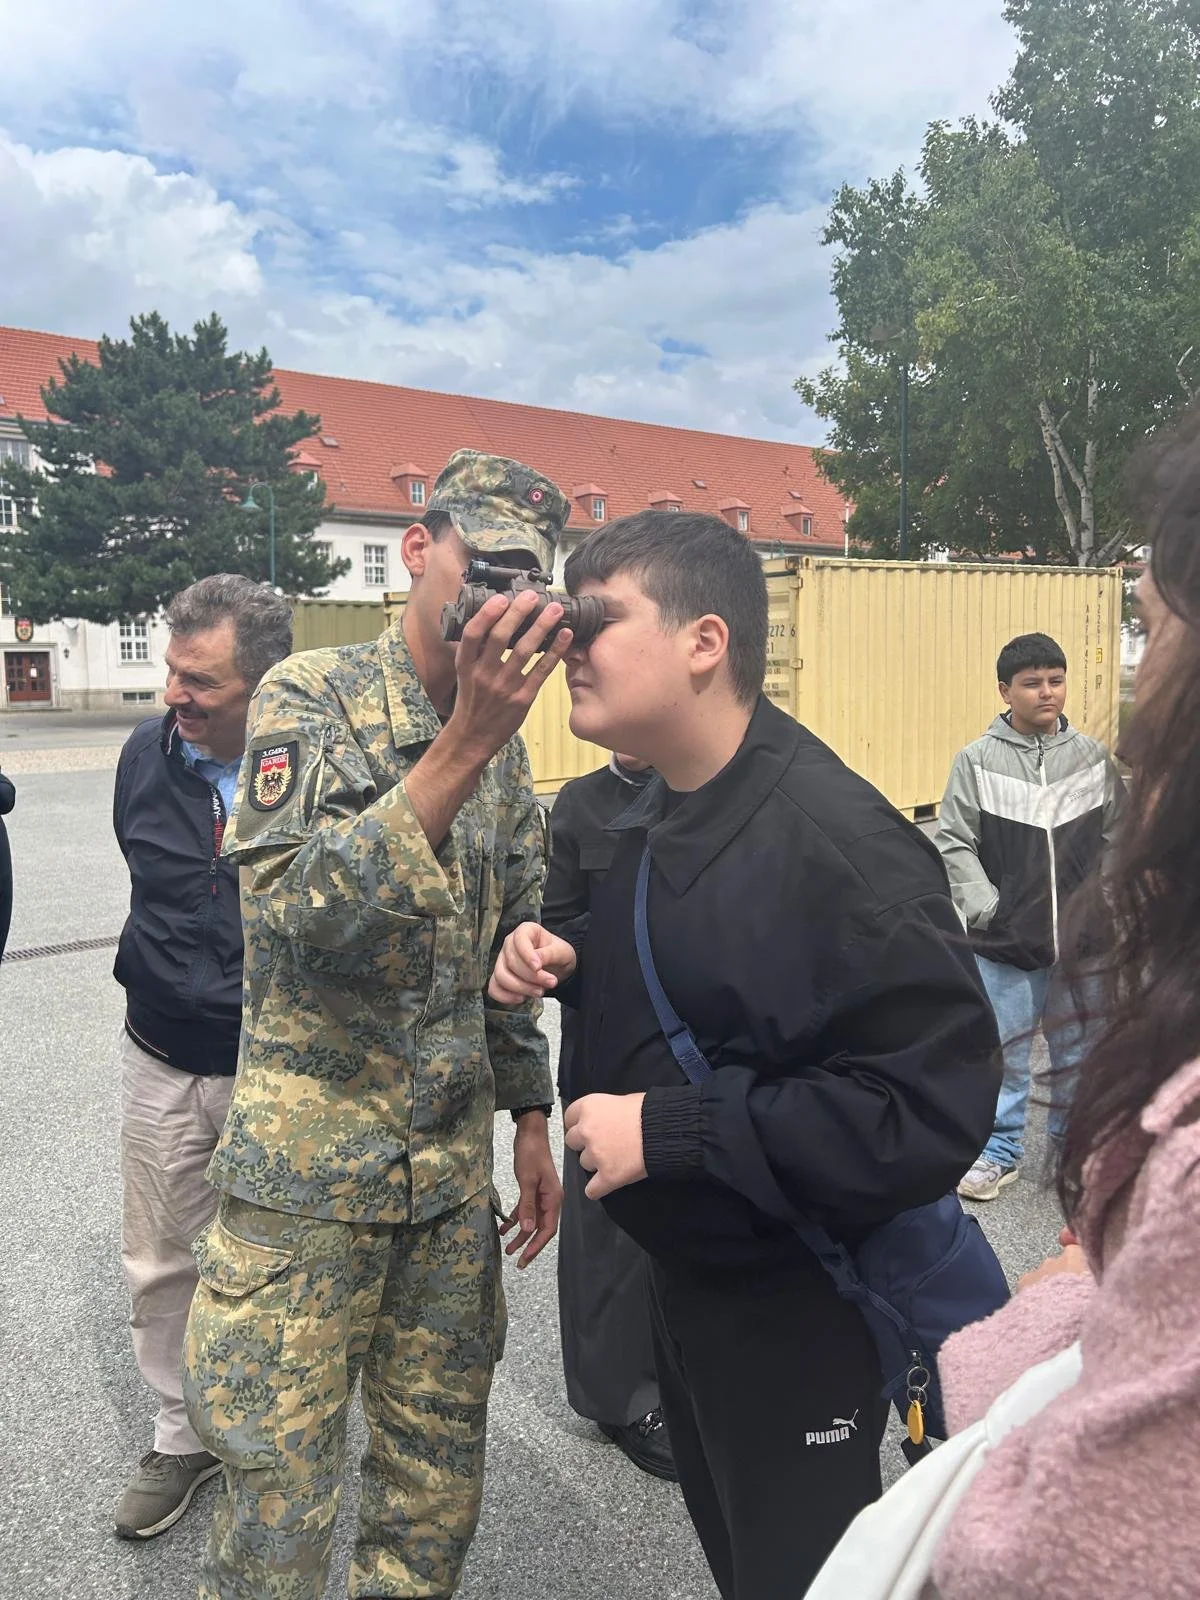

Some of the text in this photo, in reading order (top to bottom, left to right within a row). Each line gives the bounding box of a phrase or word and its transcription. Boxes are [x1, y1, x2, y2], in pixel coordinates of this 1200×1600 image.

[790, 624, 796, 637] 6
[262, 755, 287, 767] GARDE
[806, 1427, 850, 1445] PUMA
